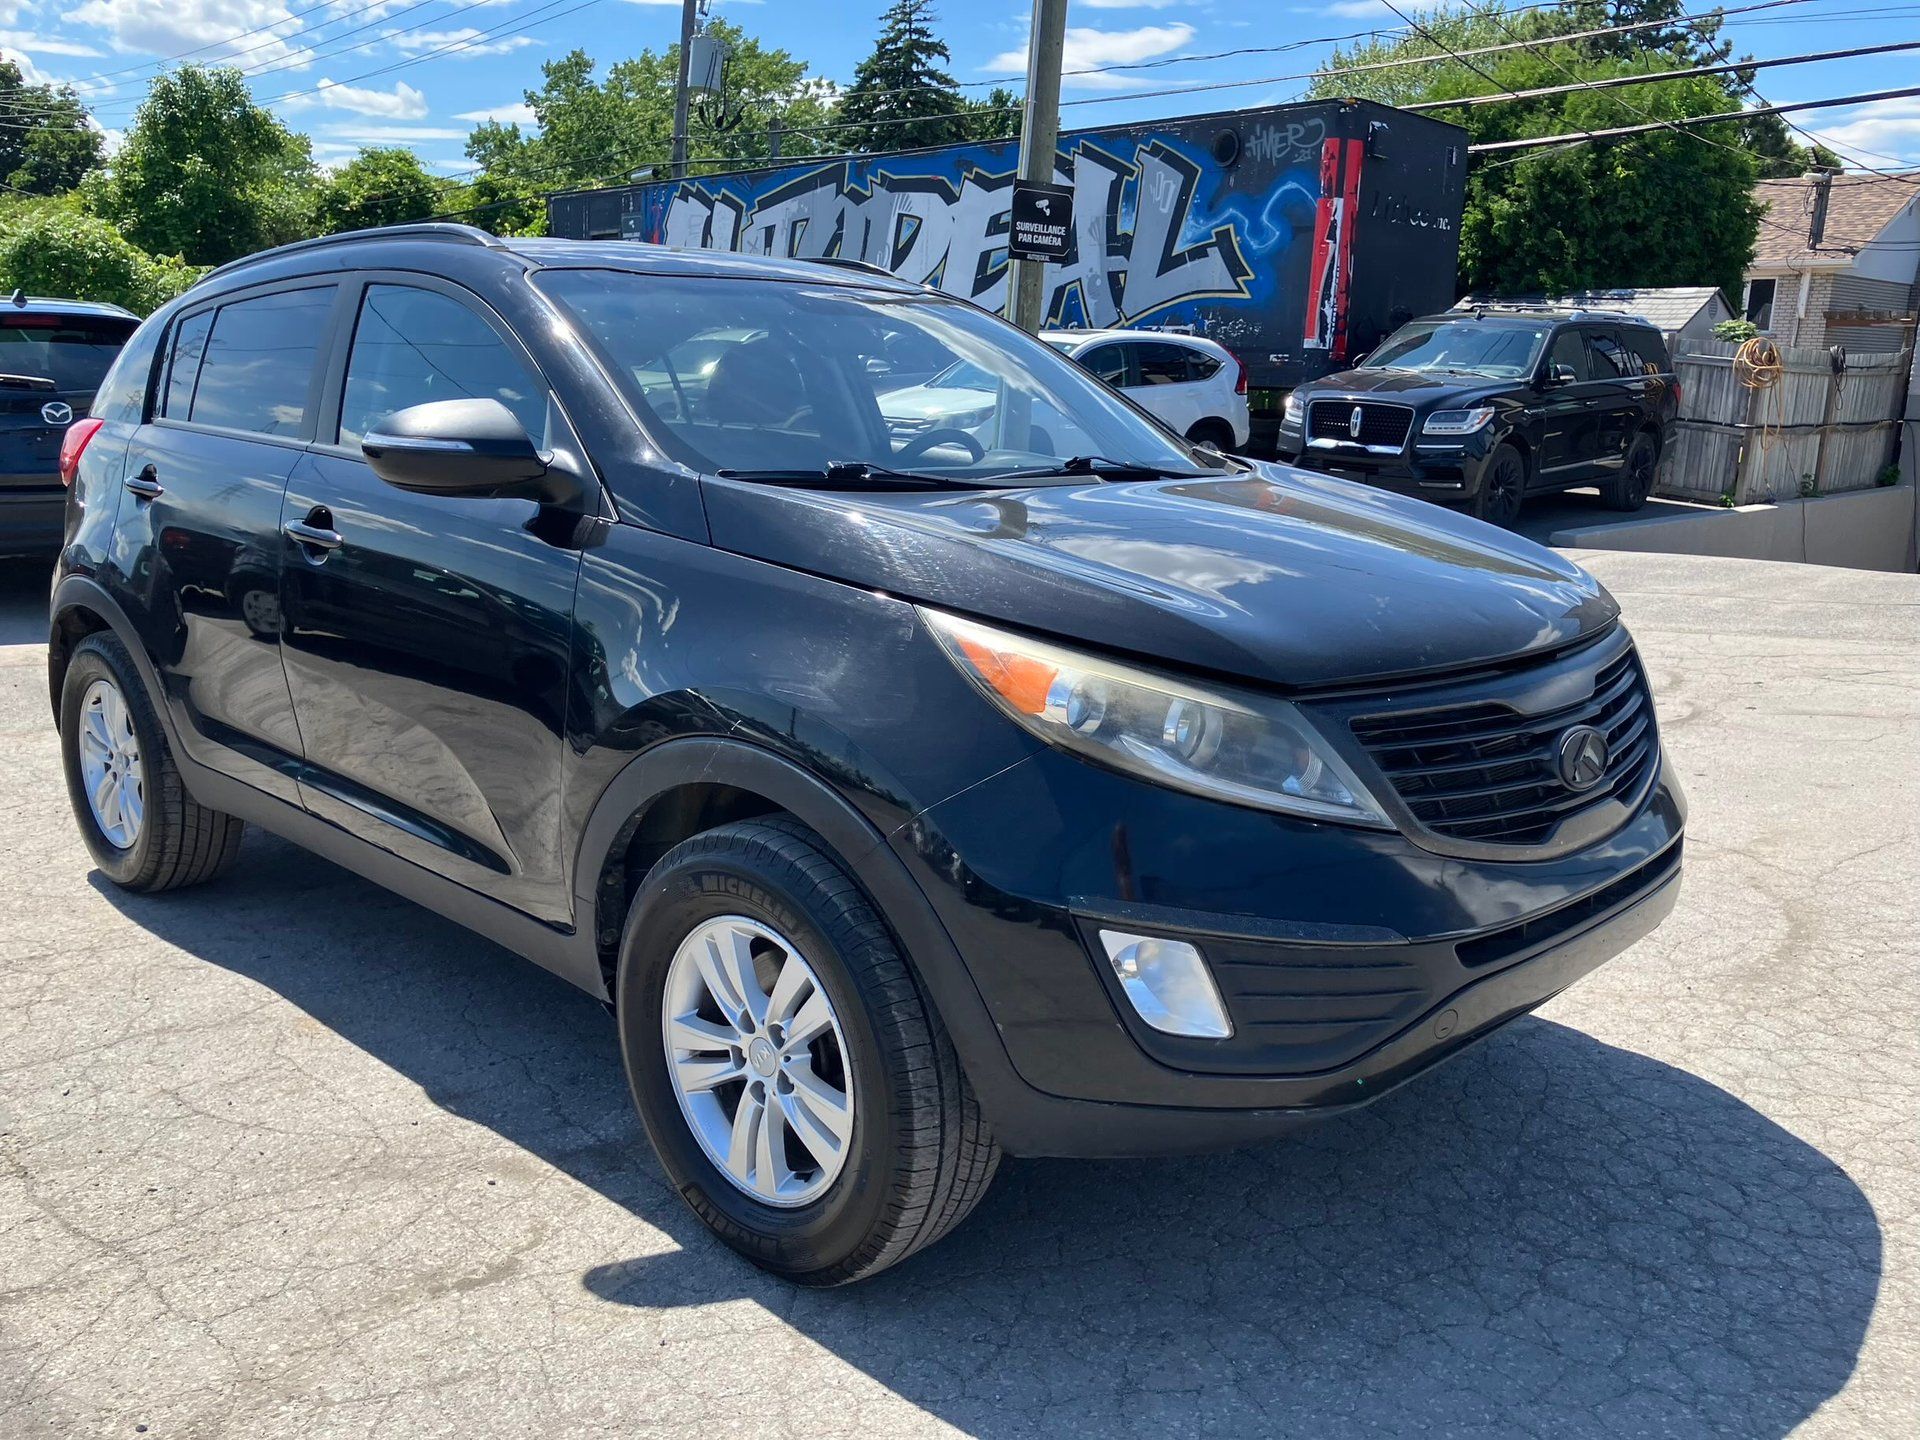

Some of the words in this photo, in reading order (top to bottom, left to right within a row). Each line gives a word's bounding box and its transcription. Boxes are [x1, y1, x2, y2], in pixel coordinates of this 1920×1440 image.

[1016, 221, 1066, 235] SURVEILLANCE
[1018, 233, 1032, 243] PAR
[1033, 235, 1062, 246] CAMÉRA
[701, 873, 798, 931] MICHELIN
